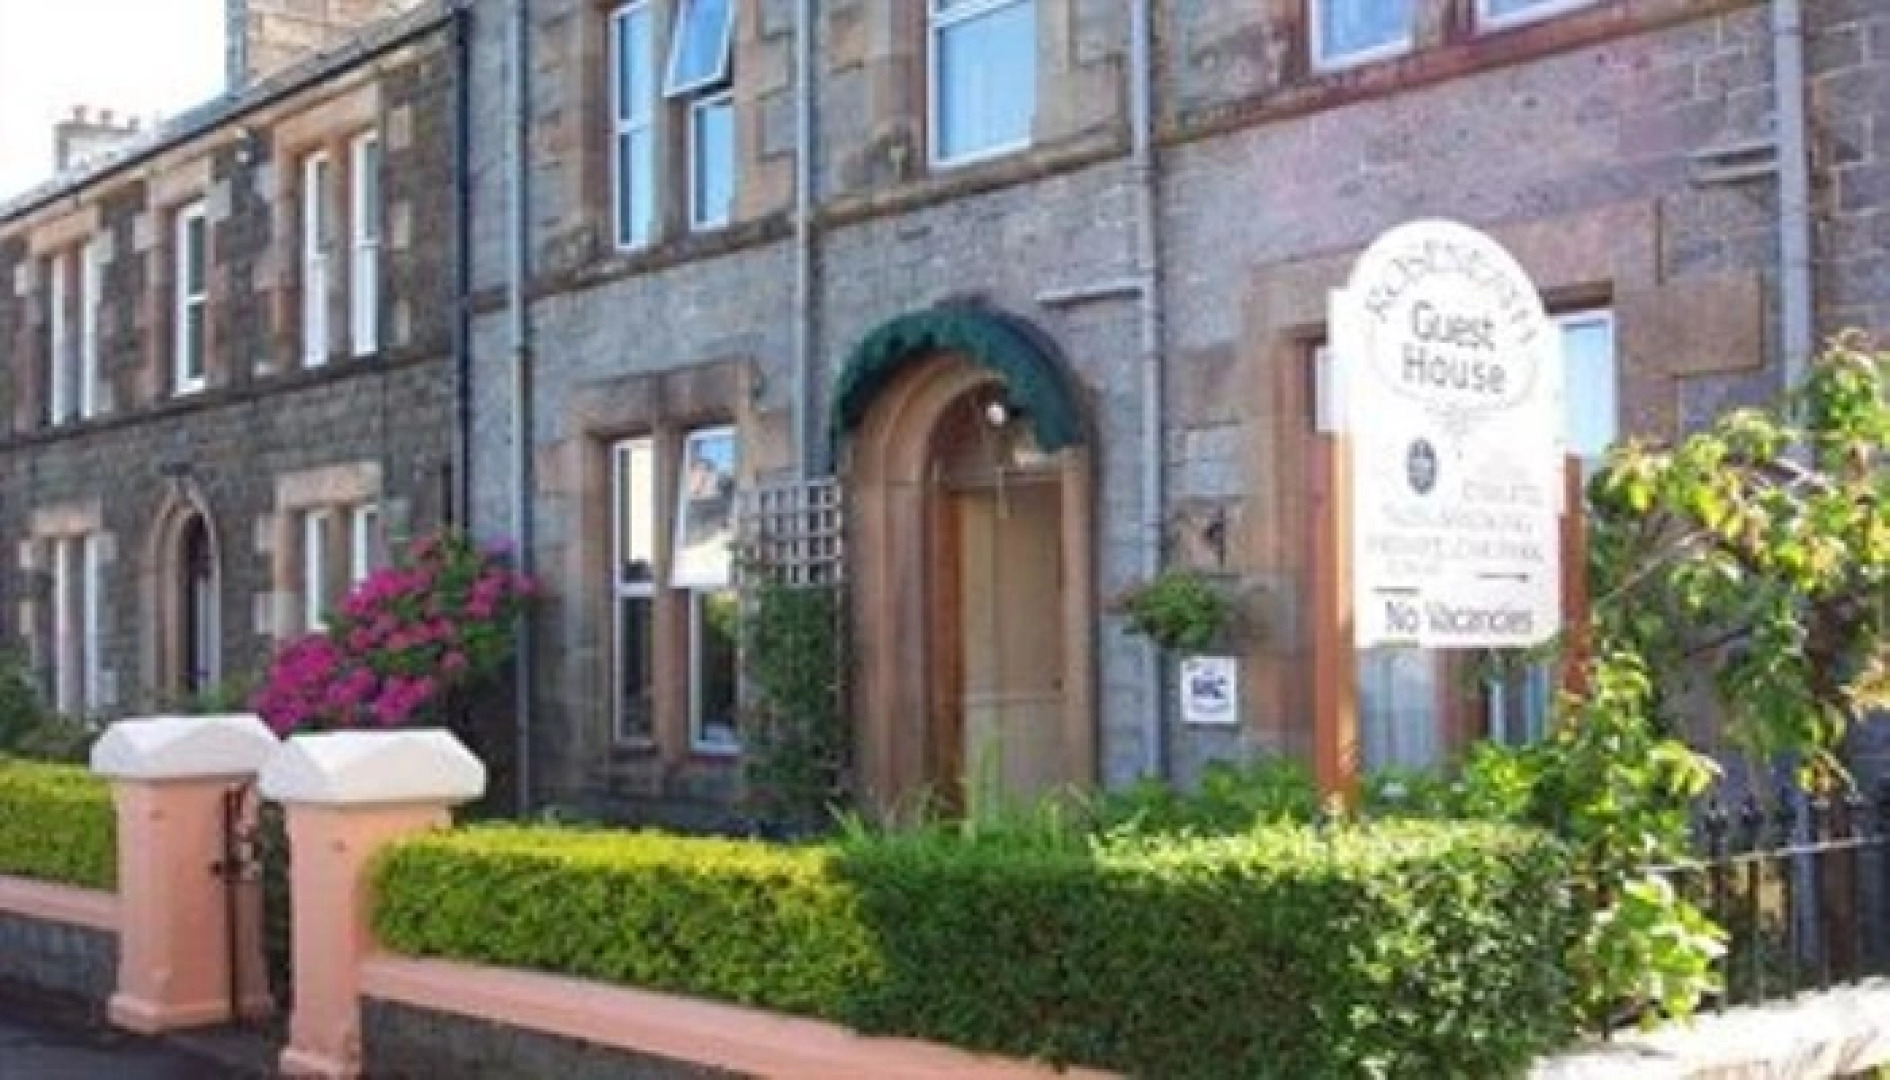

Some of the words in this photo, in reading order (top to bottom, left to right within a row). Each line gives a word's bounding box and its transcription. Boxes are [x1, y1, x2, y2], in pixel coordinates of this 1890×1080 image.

[1412, 300, 1496, 351] Guest
[1401, 343, 1507, 393] House
[1385, 600, 1421, 633] No
[1424, 601, 1533, 634] Vacancies
